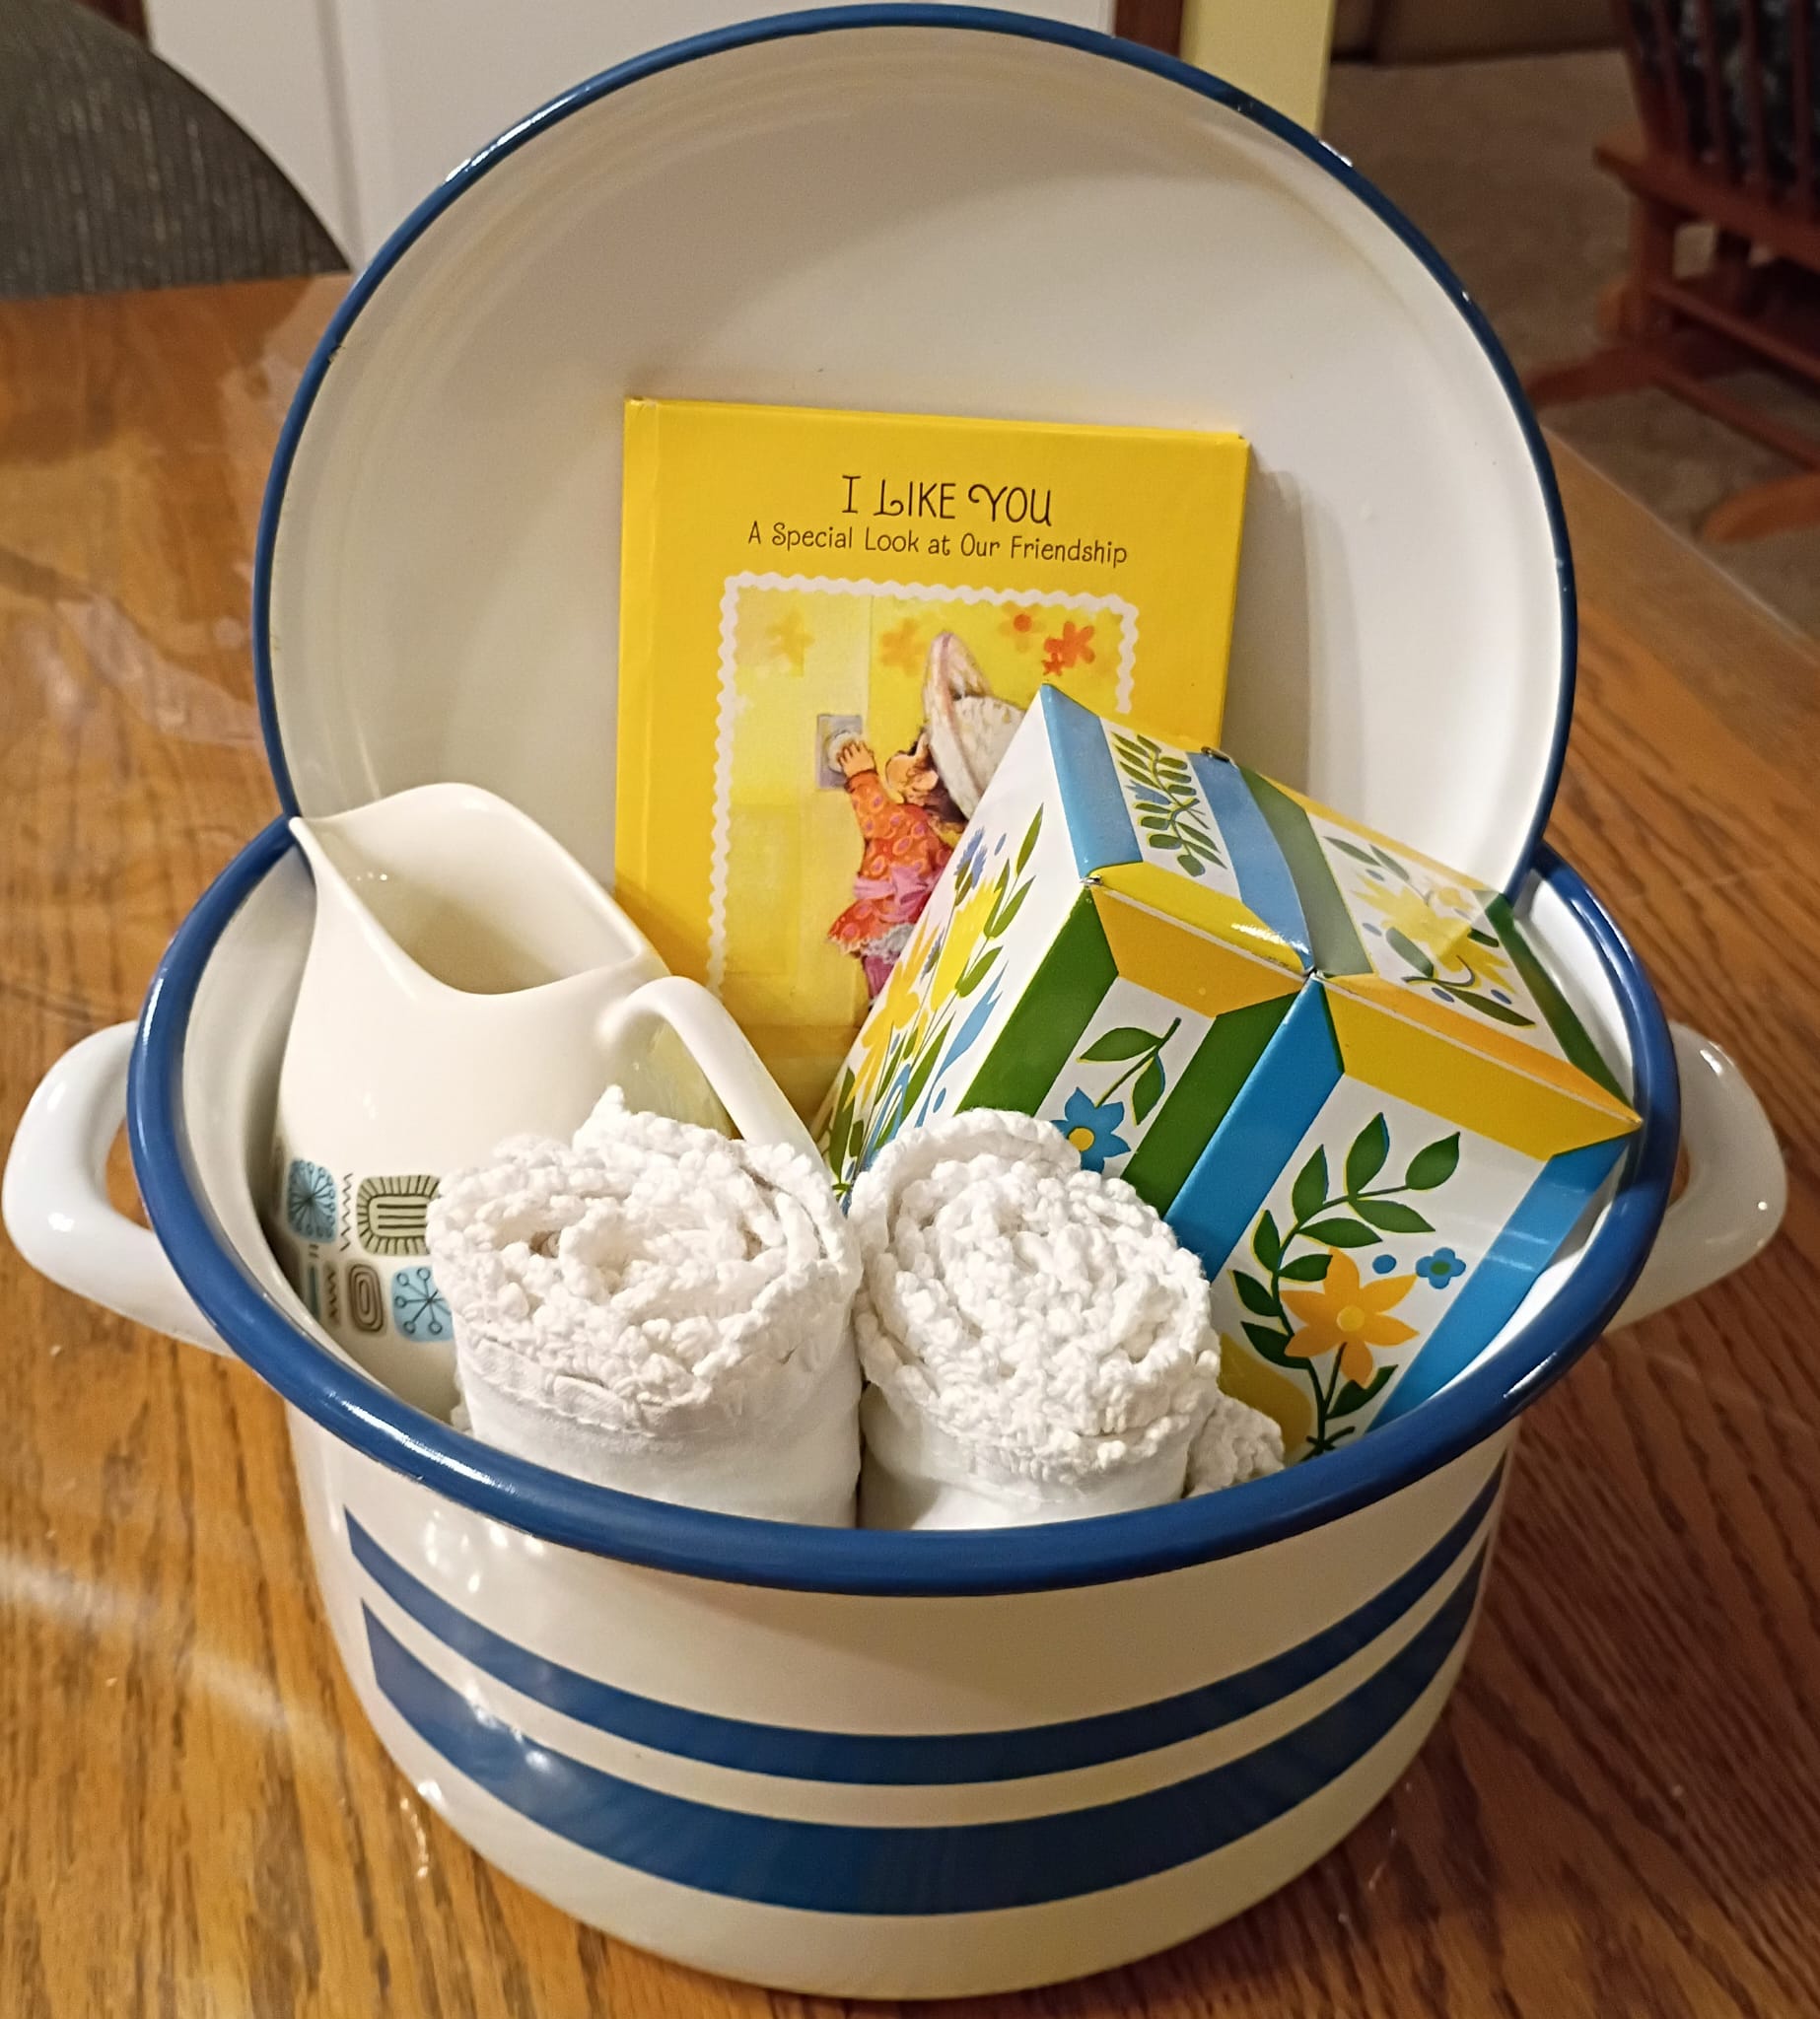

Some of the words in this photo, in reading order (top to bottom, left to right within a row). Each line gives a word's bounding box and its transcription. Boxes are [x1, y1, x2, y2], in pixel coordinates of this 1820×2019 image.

[841, 474, 862, 515] I
[873, 478, 957, 520] LIKE
[967, 483, 1053, 527] YOU
[747, 520, 762, 545] A
[771, 522, 853, 552] Special
[864, 526, 920, 553] Look
[927, 534, 951, 557] at
[960, 532, 1001, 557] Our
[1011, 534, 1128, 569] Friendship
